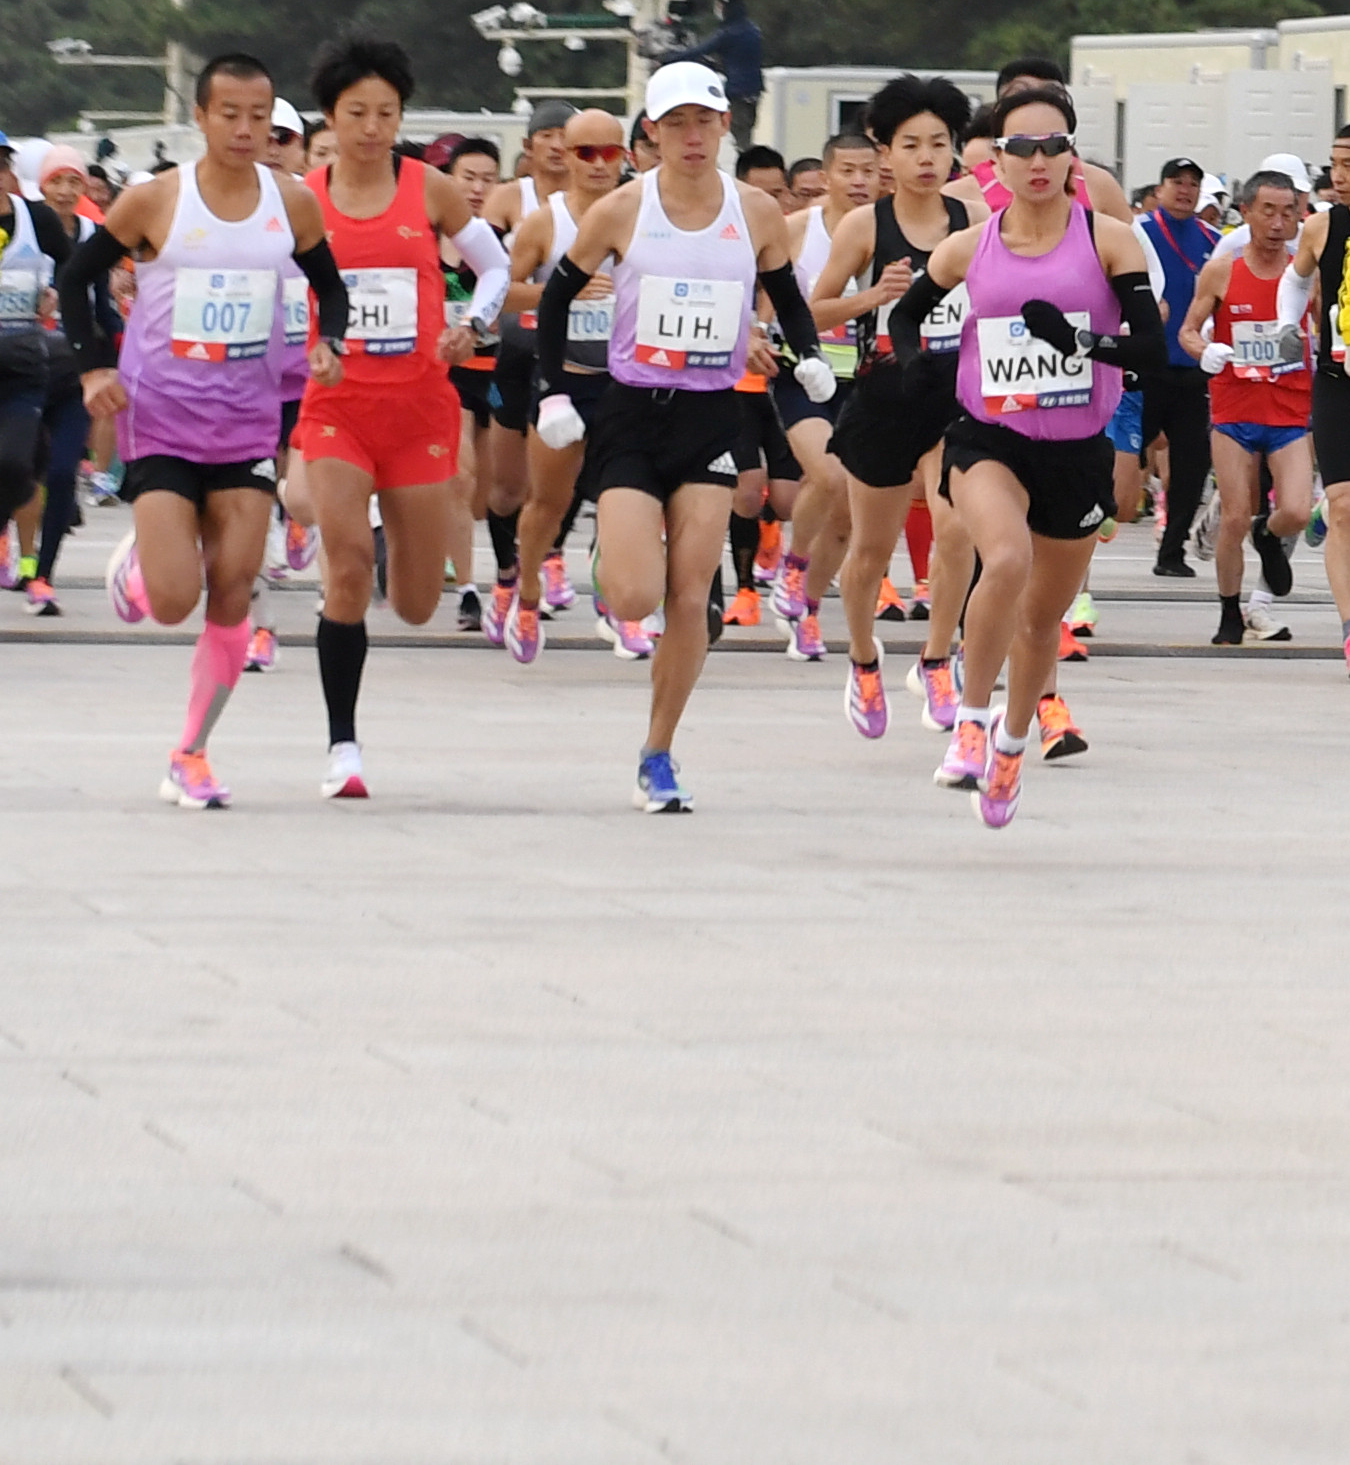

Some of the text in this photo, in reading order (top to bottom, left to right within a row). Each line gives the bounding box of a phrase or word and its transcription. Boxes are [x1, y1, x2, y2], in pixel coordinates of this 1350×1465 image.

[201, 302, 252, 333] 007
[658, 314, 719, 340] LI H.
[1238, 339, 1281, 361] T00
[987, 353, 1084, 383] WANG
